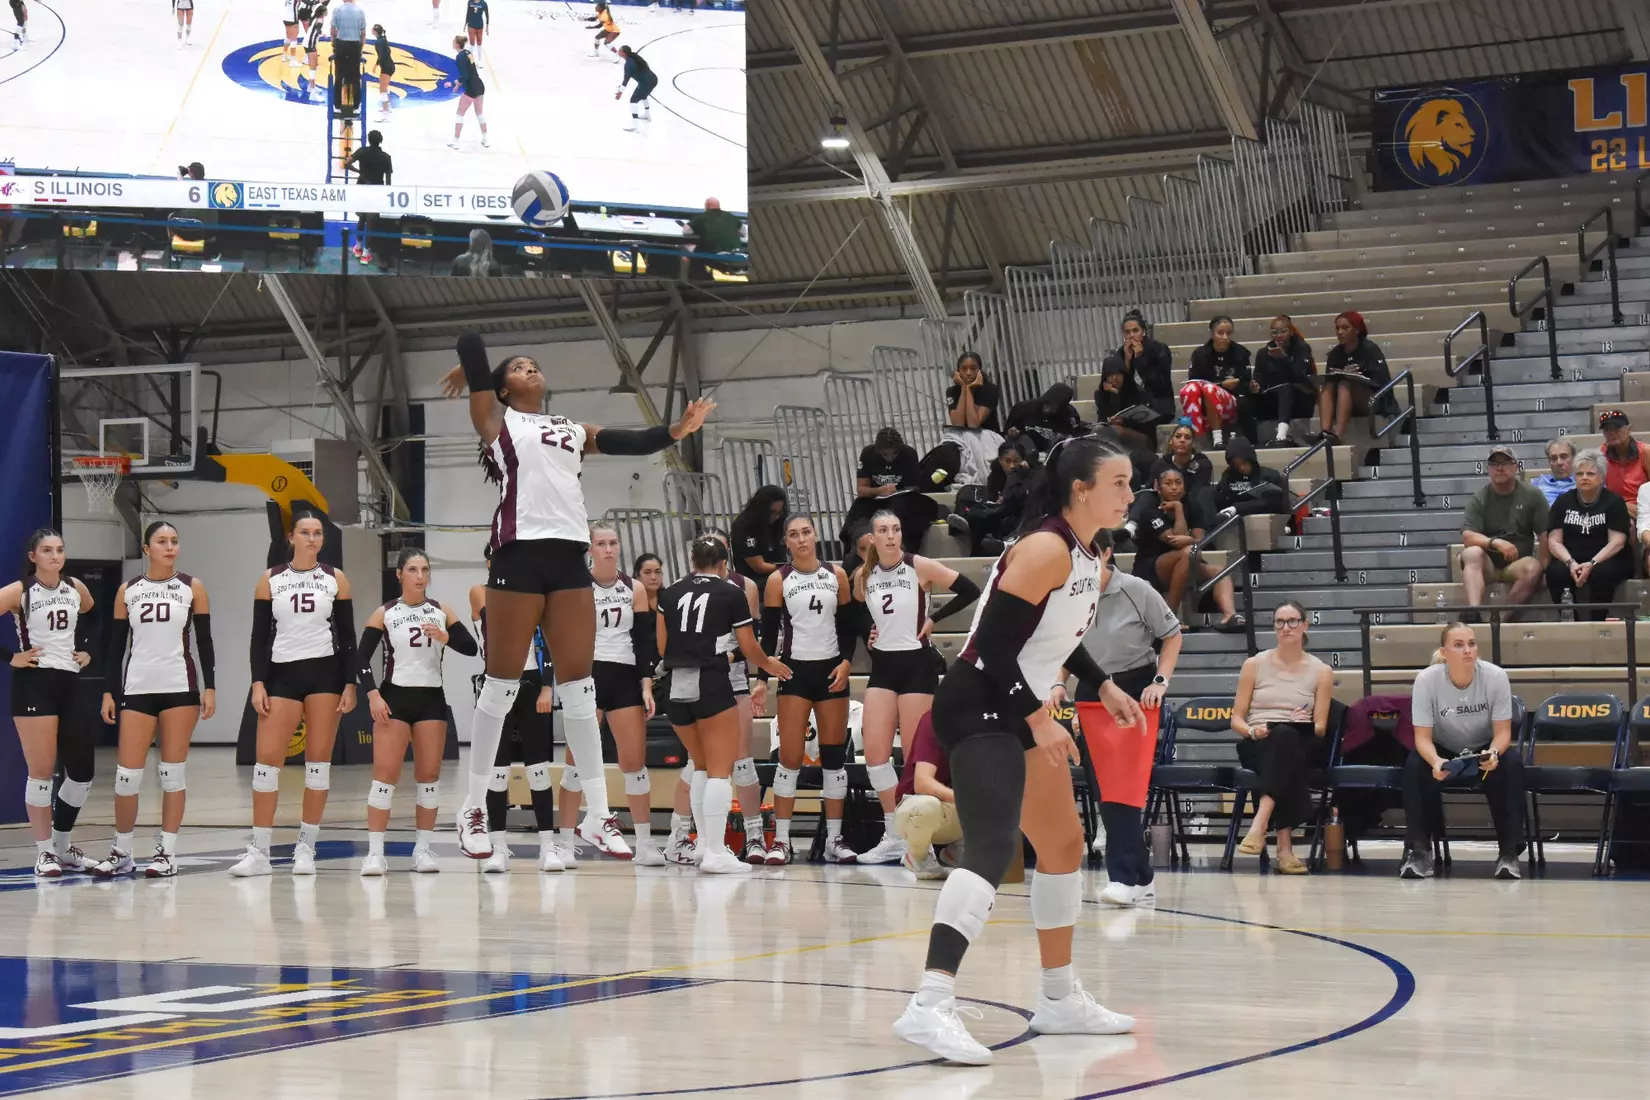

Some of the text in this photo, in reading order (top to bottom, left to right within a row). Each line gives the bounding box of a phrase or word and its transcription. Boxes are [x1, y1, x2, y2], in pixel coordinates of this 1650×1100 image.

[1568, 73, 1648, 132] LI
[1591, 137, 1627, 172] 22
[34, 181, 123, 196] S ILLINOIS
[188, 186, 201, 203] 6
[248, 187, 346, 202] EAST TEXAS A&M
[386, 191, 409, 208] 10
[423, 194, 452, 207] SET
[458, 195, 464, 207] 1
[540, 425, 575, 453] 22
[1512, 430, 1523, 441] 10
[1372, 466, 1379, 479] A
[1476, 462, 1482, 474] 9
[1443, 496, 1450, 509] 8
[1295, 536, 1301, 549] A
[1400, 533, 1406, 546] 7
[1251, 574, 1258, 587] A
[1359, 571, 1365, 584] 6
[1410, 570, 1417, 583] B
[131, 592, 159, 606] SOUTHERN
[290, 593, 315, 613] 15
[808, 595, 823, 614] 4
[882, 594, 894, 614] 2
[140, 602, 170, 623] 20
[601, 607, 622, 628] 17
[677, 592, 710, 633] 11
[1313, 611, 1320, 624] 5
[46, 610, 68, 631] 18
[1332, 652, 1340, 667] B
[1186, 707, 1234, 720] LION
[1456, 702, 1488, 715] SALUK
[1548, 703, 1610, 719] LIONS
[357, 730, 373, 744] lio
[1185, 798, 1192, 813] B
